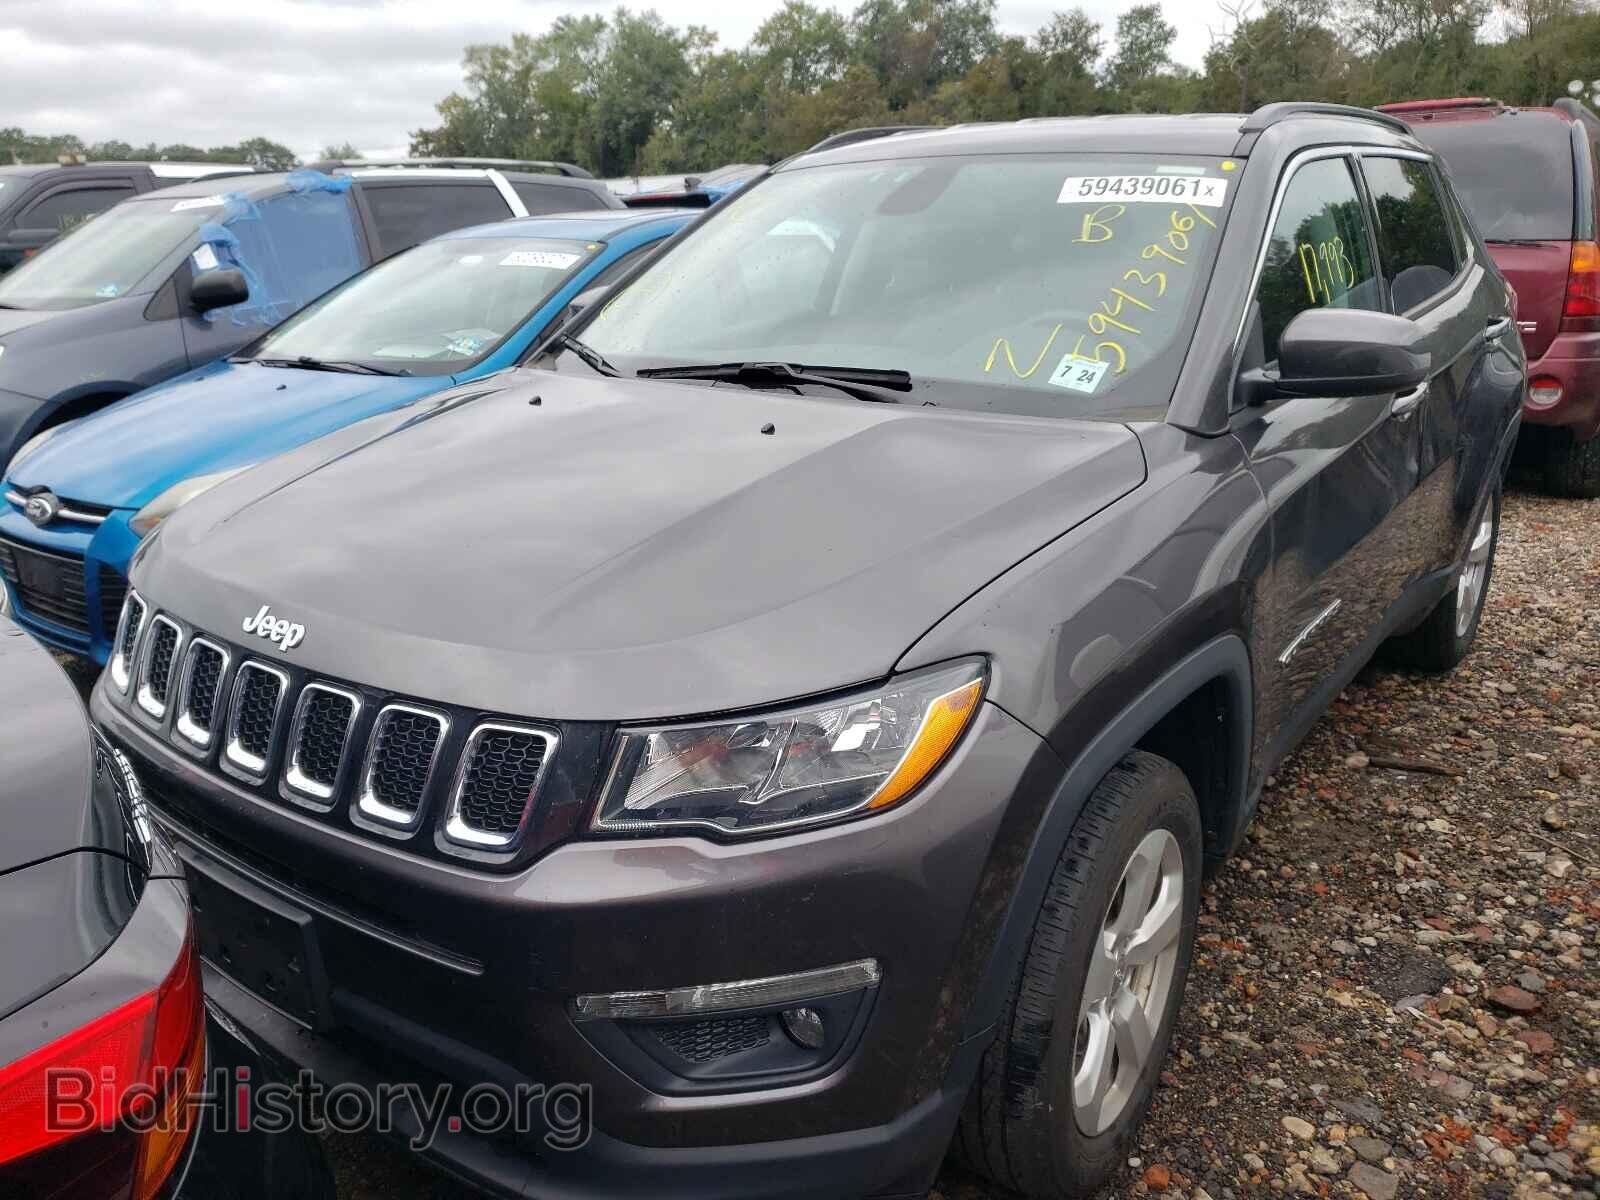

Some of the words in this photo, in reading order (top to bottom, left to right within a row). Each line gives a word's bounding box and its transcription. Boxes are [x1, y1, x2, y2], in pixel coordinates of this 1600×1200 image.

[1071, 200, 1217, 375] 59439061
[1060, 365, 1073, 378] 7
[1076, 369, 1097, 384] 24
[242, 605, 305, 653] Jeep
